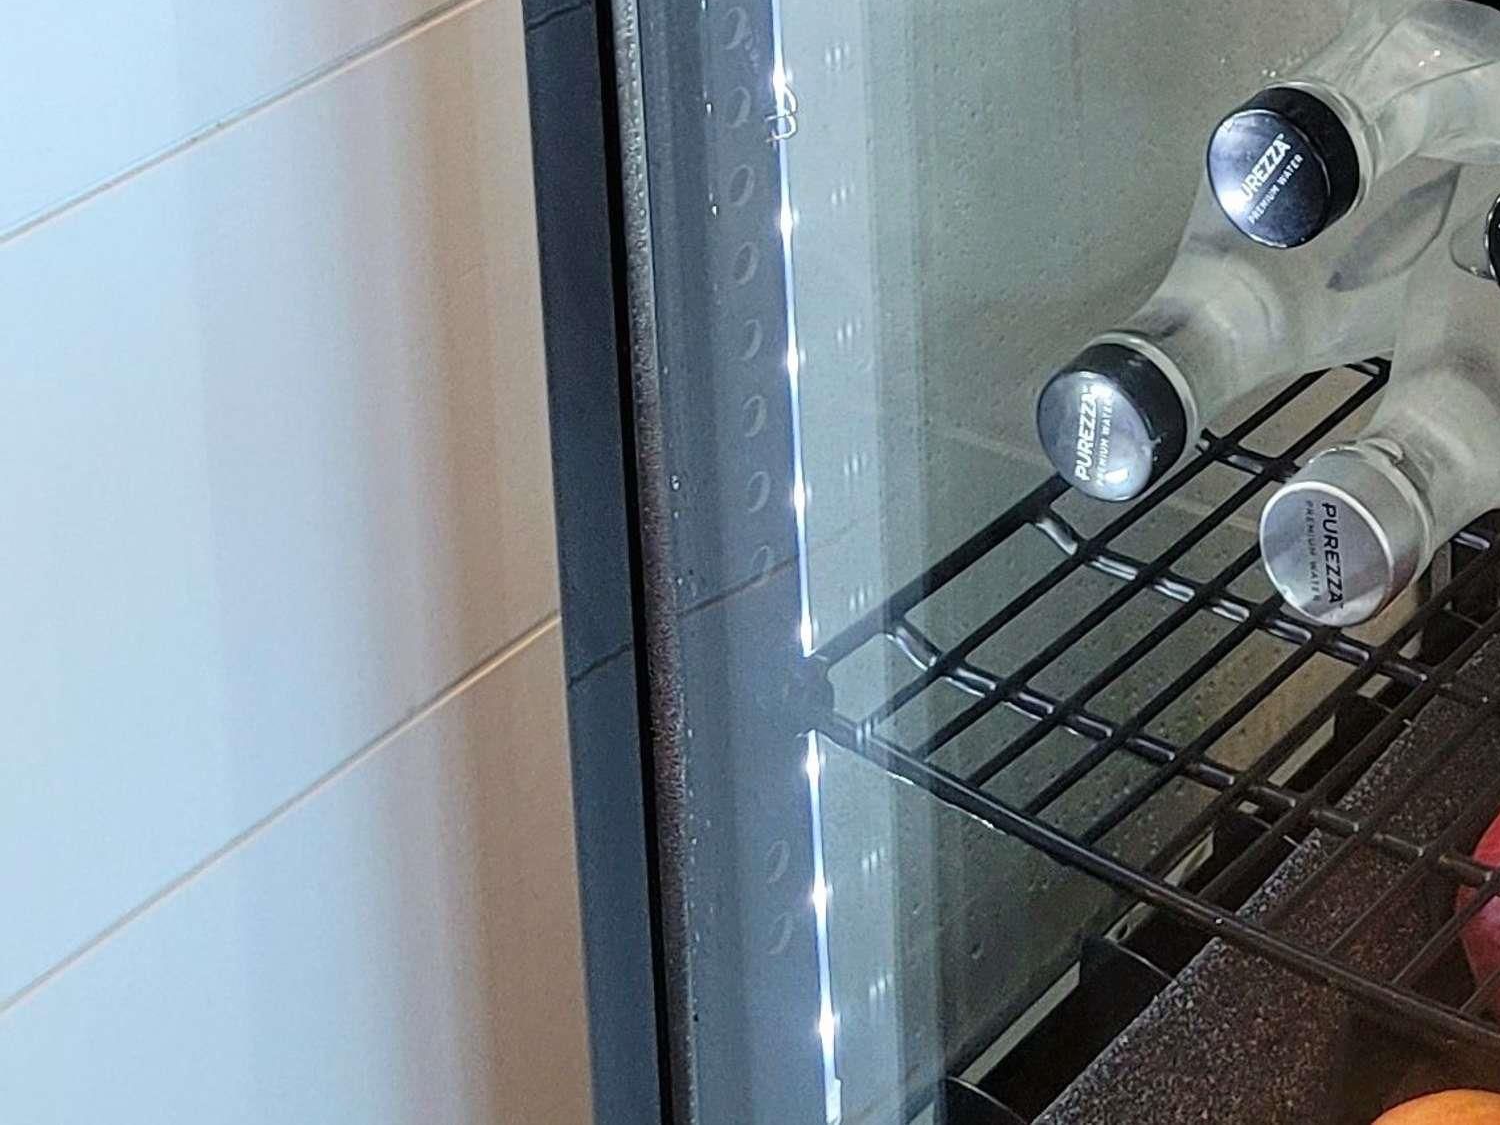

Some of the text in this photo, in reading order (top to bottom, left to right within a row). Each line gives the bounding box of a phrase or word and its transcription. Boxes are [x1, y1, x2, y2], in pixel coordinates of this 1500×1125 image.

[1240, 135, 1292, 201] UREZZA
[1248, 154, 1304, 224] PREMIUM WATER
[1074, 390, 1098, 481] PUREZZA
[1302, 500, 1321, 602] PREMIUM WATER
[1322, 502, 1344, 605] PUREZZA
